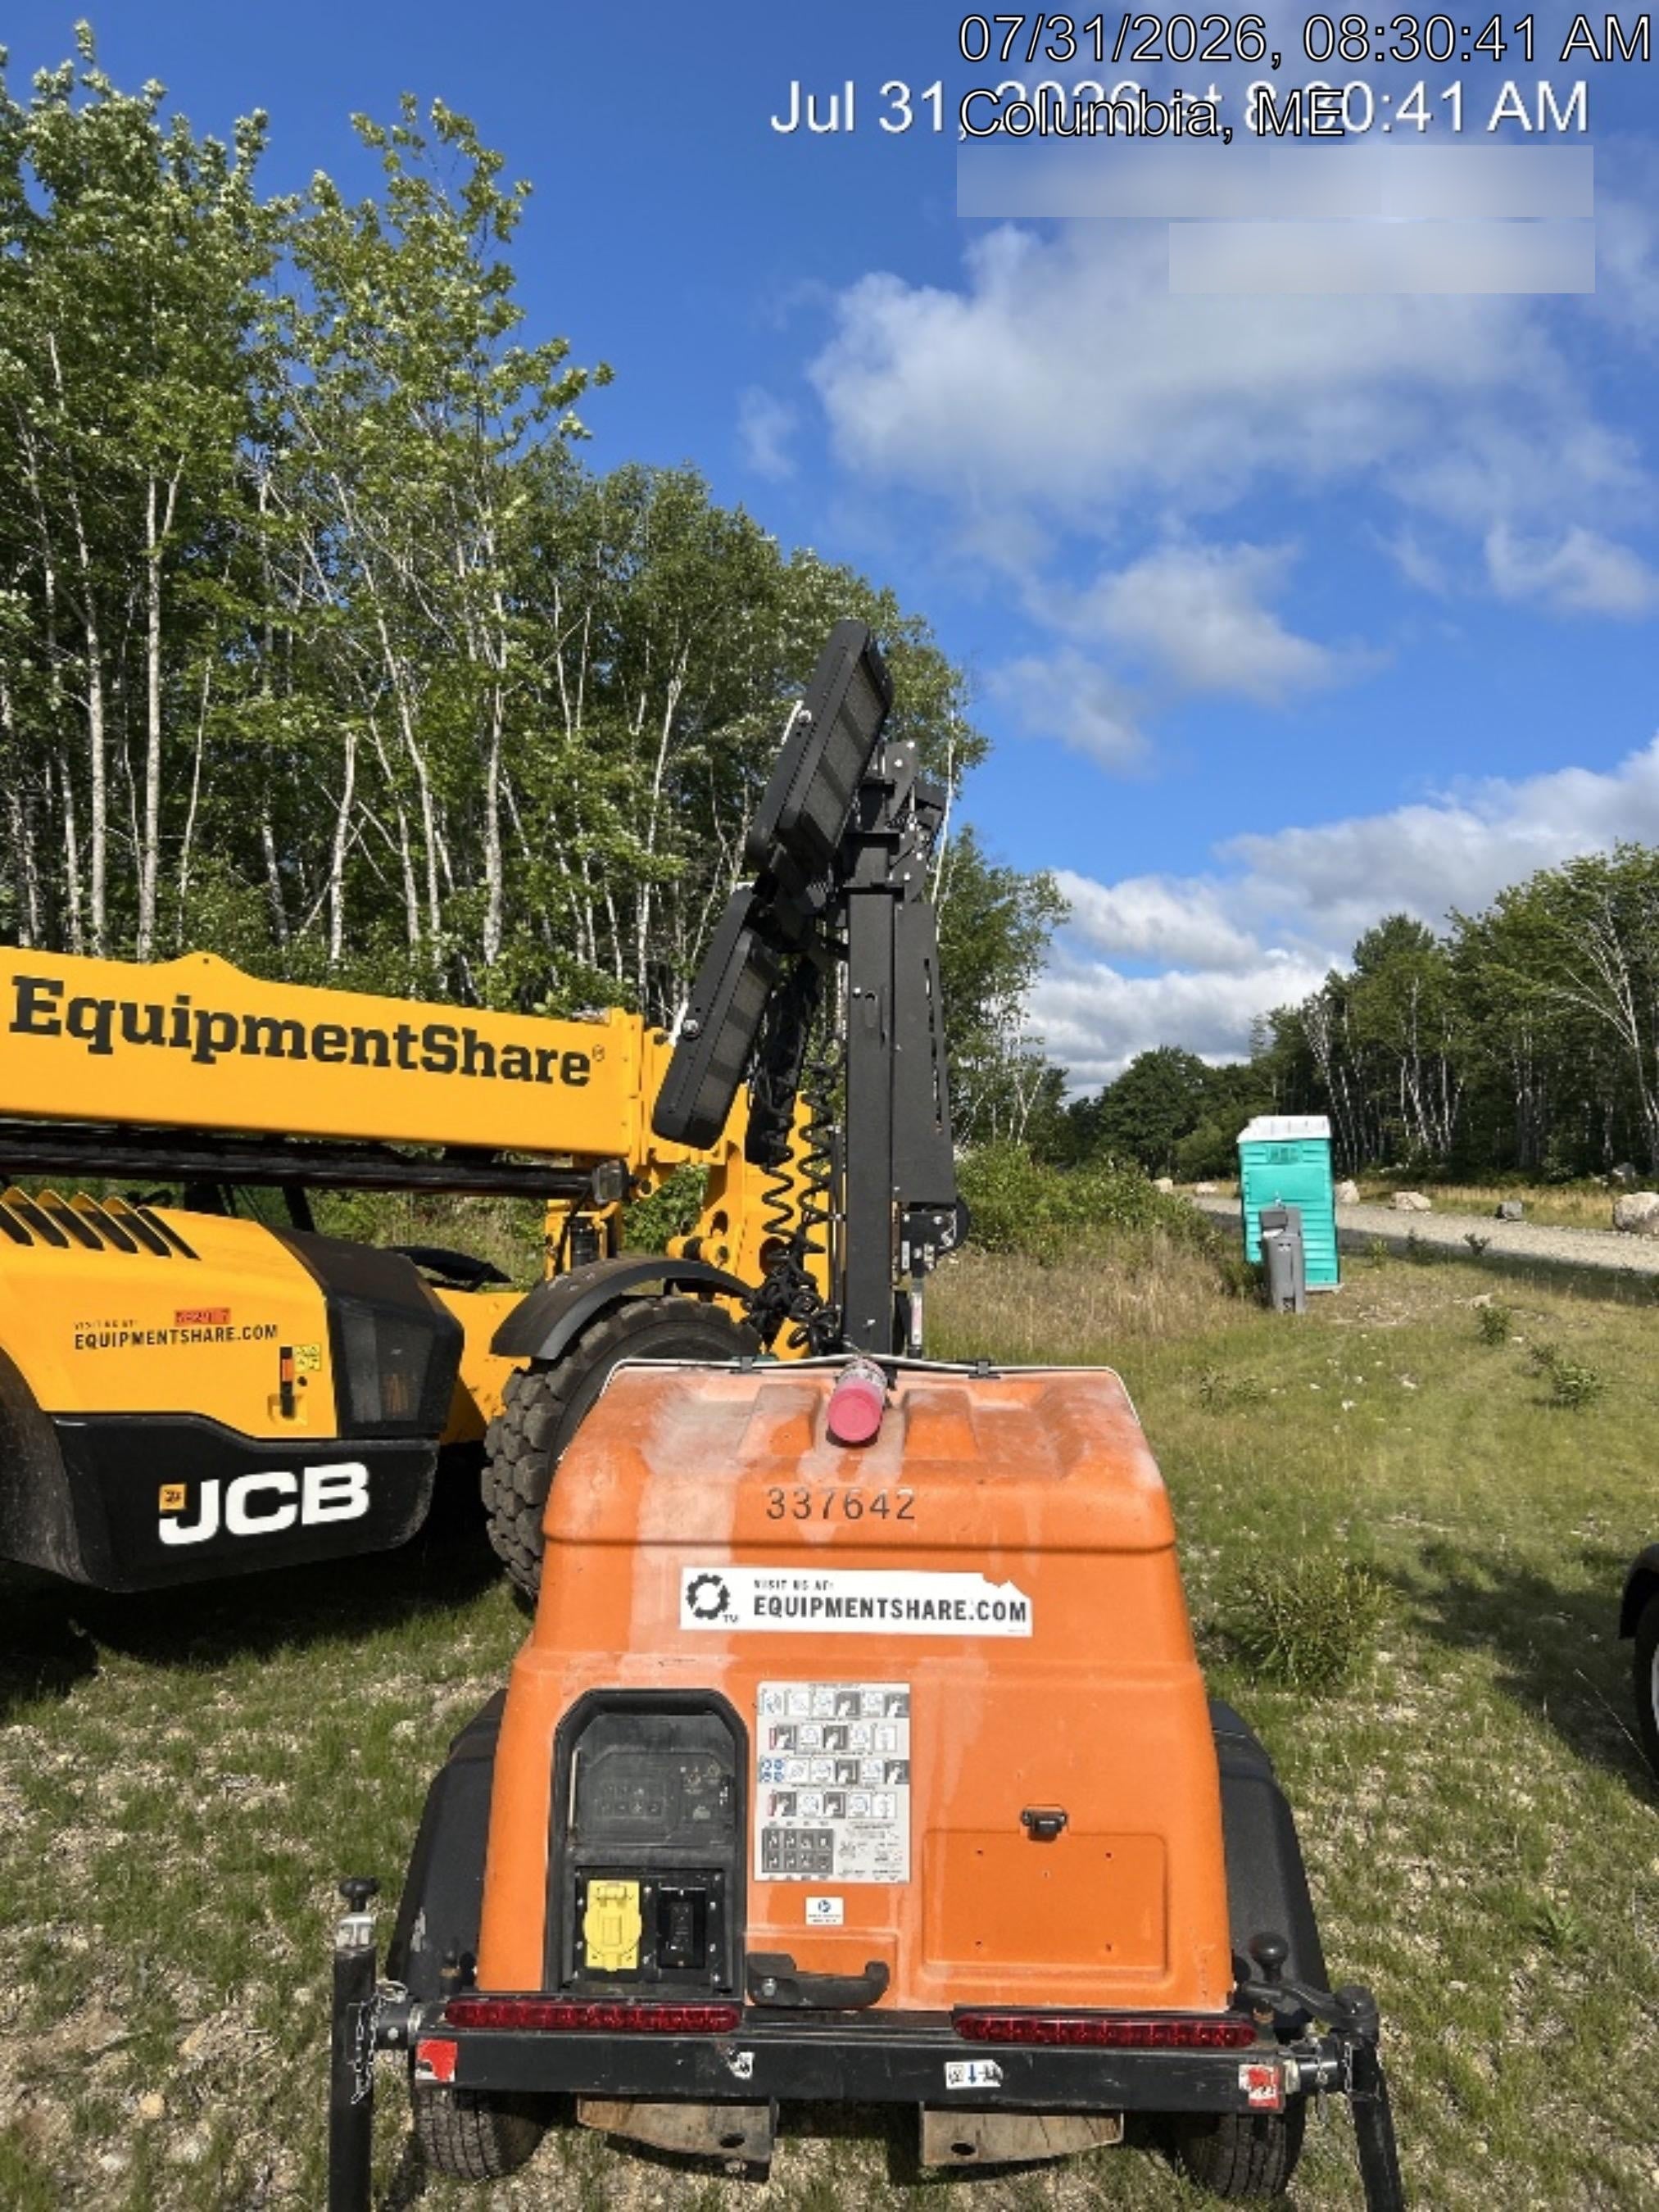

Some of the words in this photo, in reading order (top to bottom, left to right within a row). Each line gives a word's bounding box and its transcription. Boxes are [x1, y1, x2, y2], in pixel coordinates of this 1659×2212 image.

[75, 1324, 279, 1350] EQUIPMENTSHARE.COM
[159, 1462, 370, 1545] JCB
[766, 1487, 916, 1520] 337642
[753, 1595, 1027, 1622] EQUIPMENTSHARE.COM
